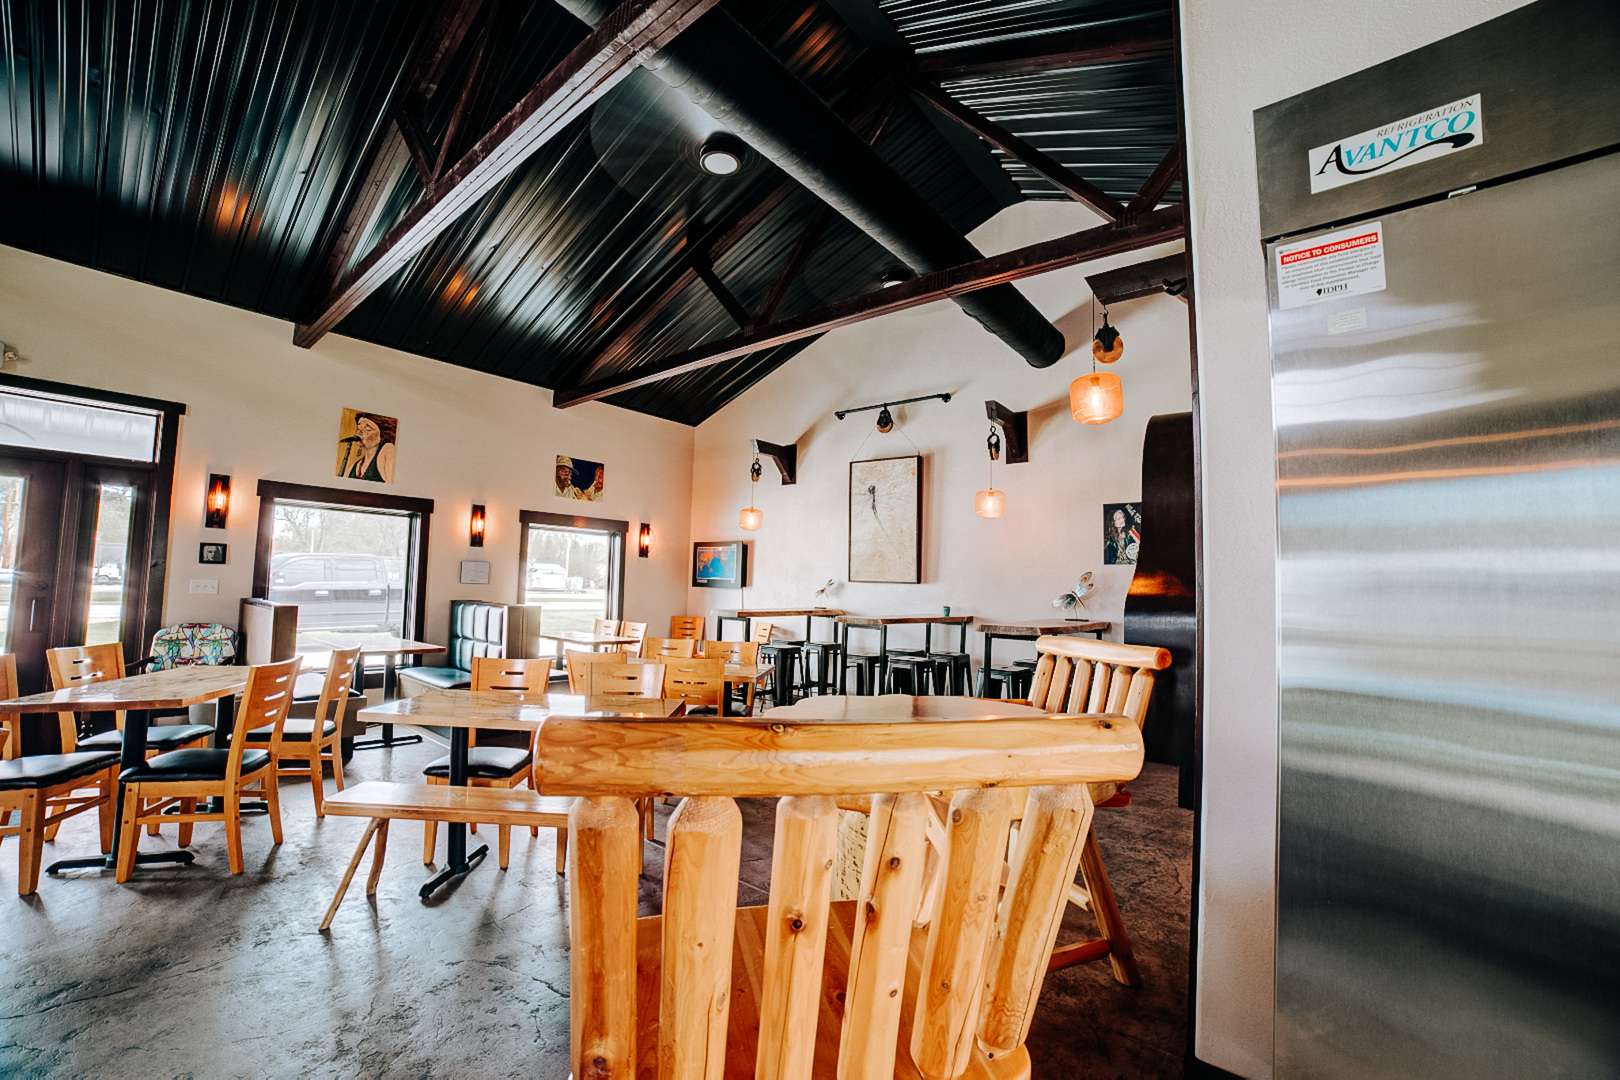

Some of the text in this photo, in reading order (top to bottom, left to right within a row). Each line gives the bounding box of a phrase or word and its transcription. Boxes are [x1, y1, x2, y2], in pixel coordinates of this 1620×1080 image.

[1377, 99, 1474, 138] REFRIGERATION
[1315, 111, 1475, 176] AVANTCO
[1283, 234, 1376, 263] NOTICE TO CONSUMERS
[1324, 284, 1348, 293] IDPH
